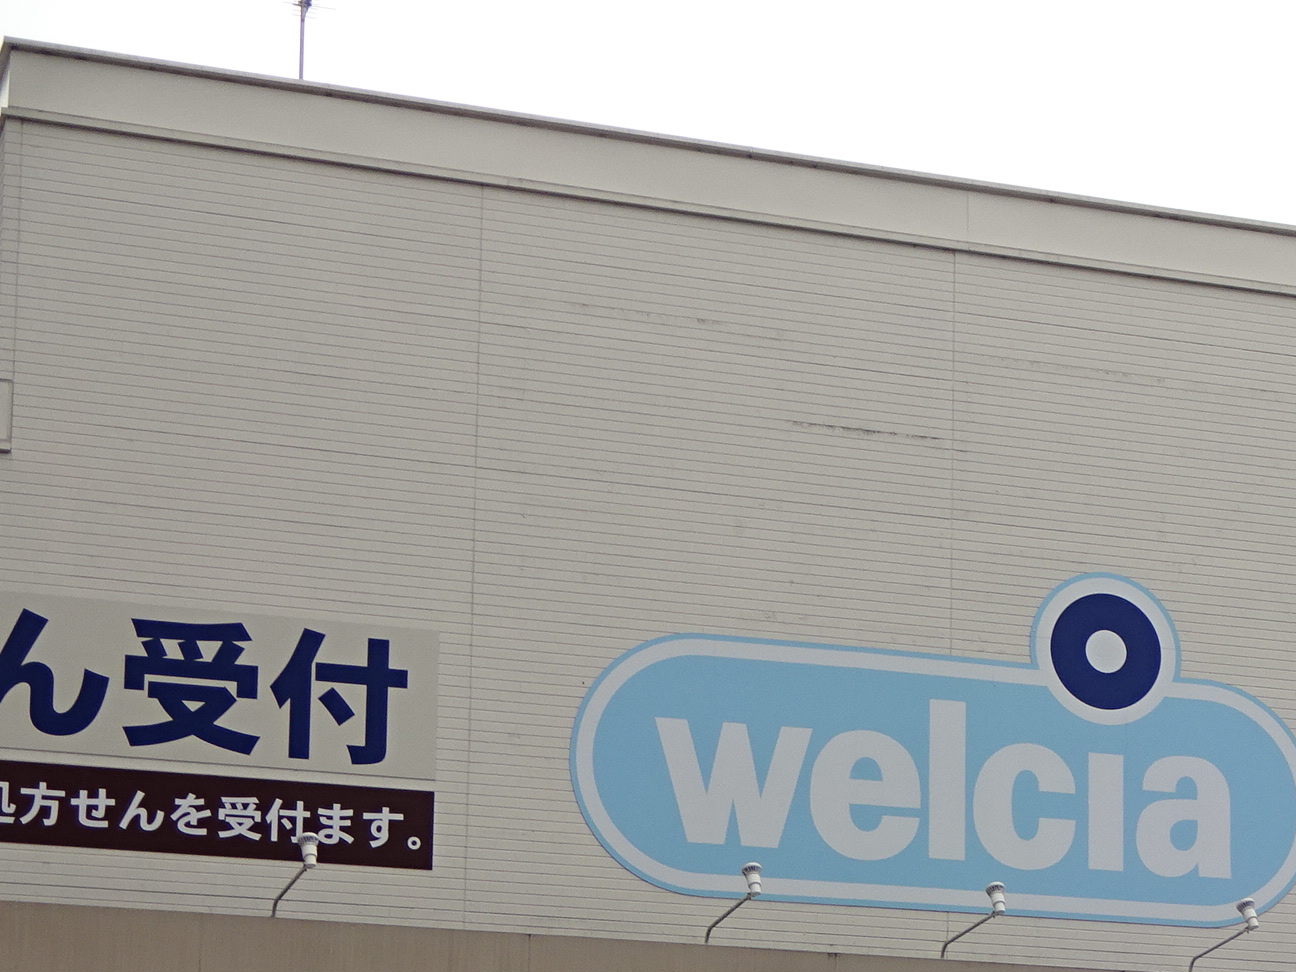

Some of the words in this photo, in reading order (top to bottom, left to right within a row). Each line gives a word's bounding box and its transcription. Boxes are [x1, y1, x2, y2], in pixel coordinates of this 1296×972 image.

[0, 608, 408, 765] ん受付
[654, 697, 1233, 880] welcia
